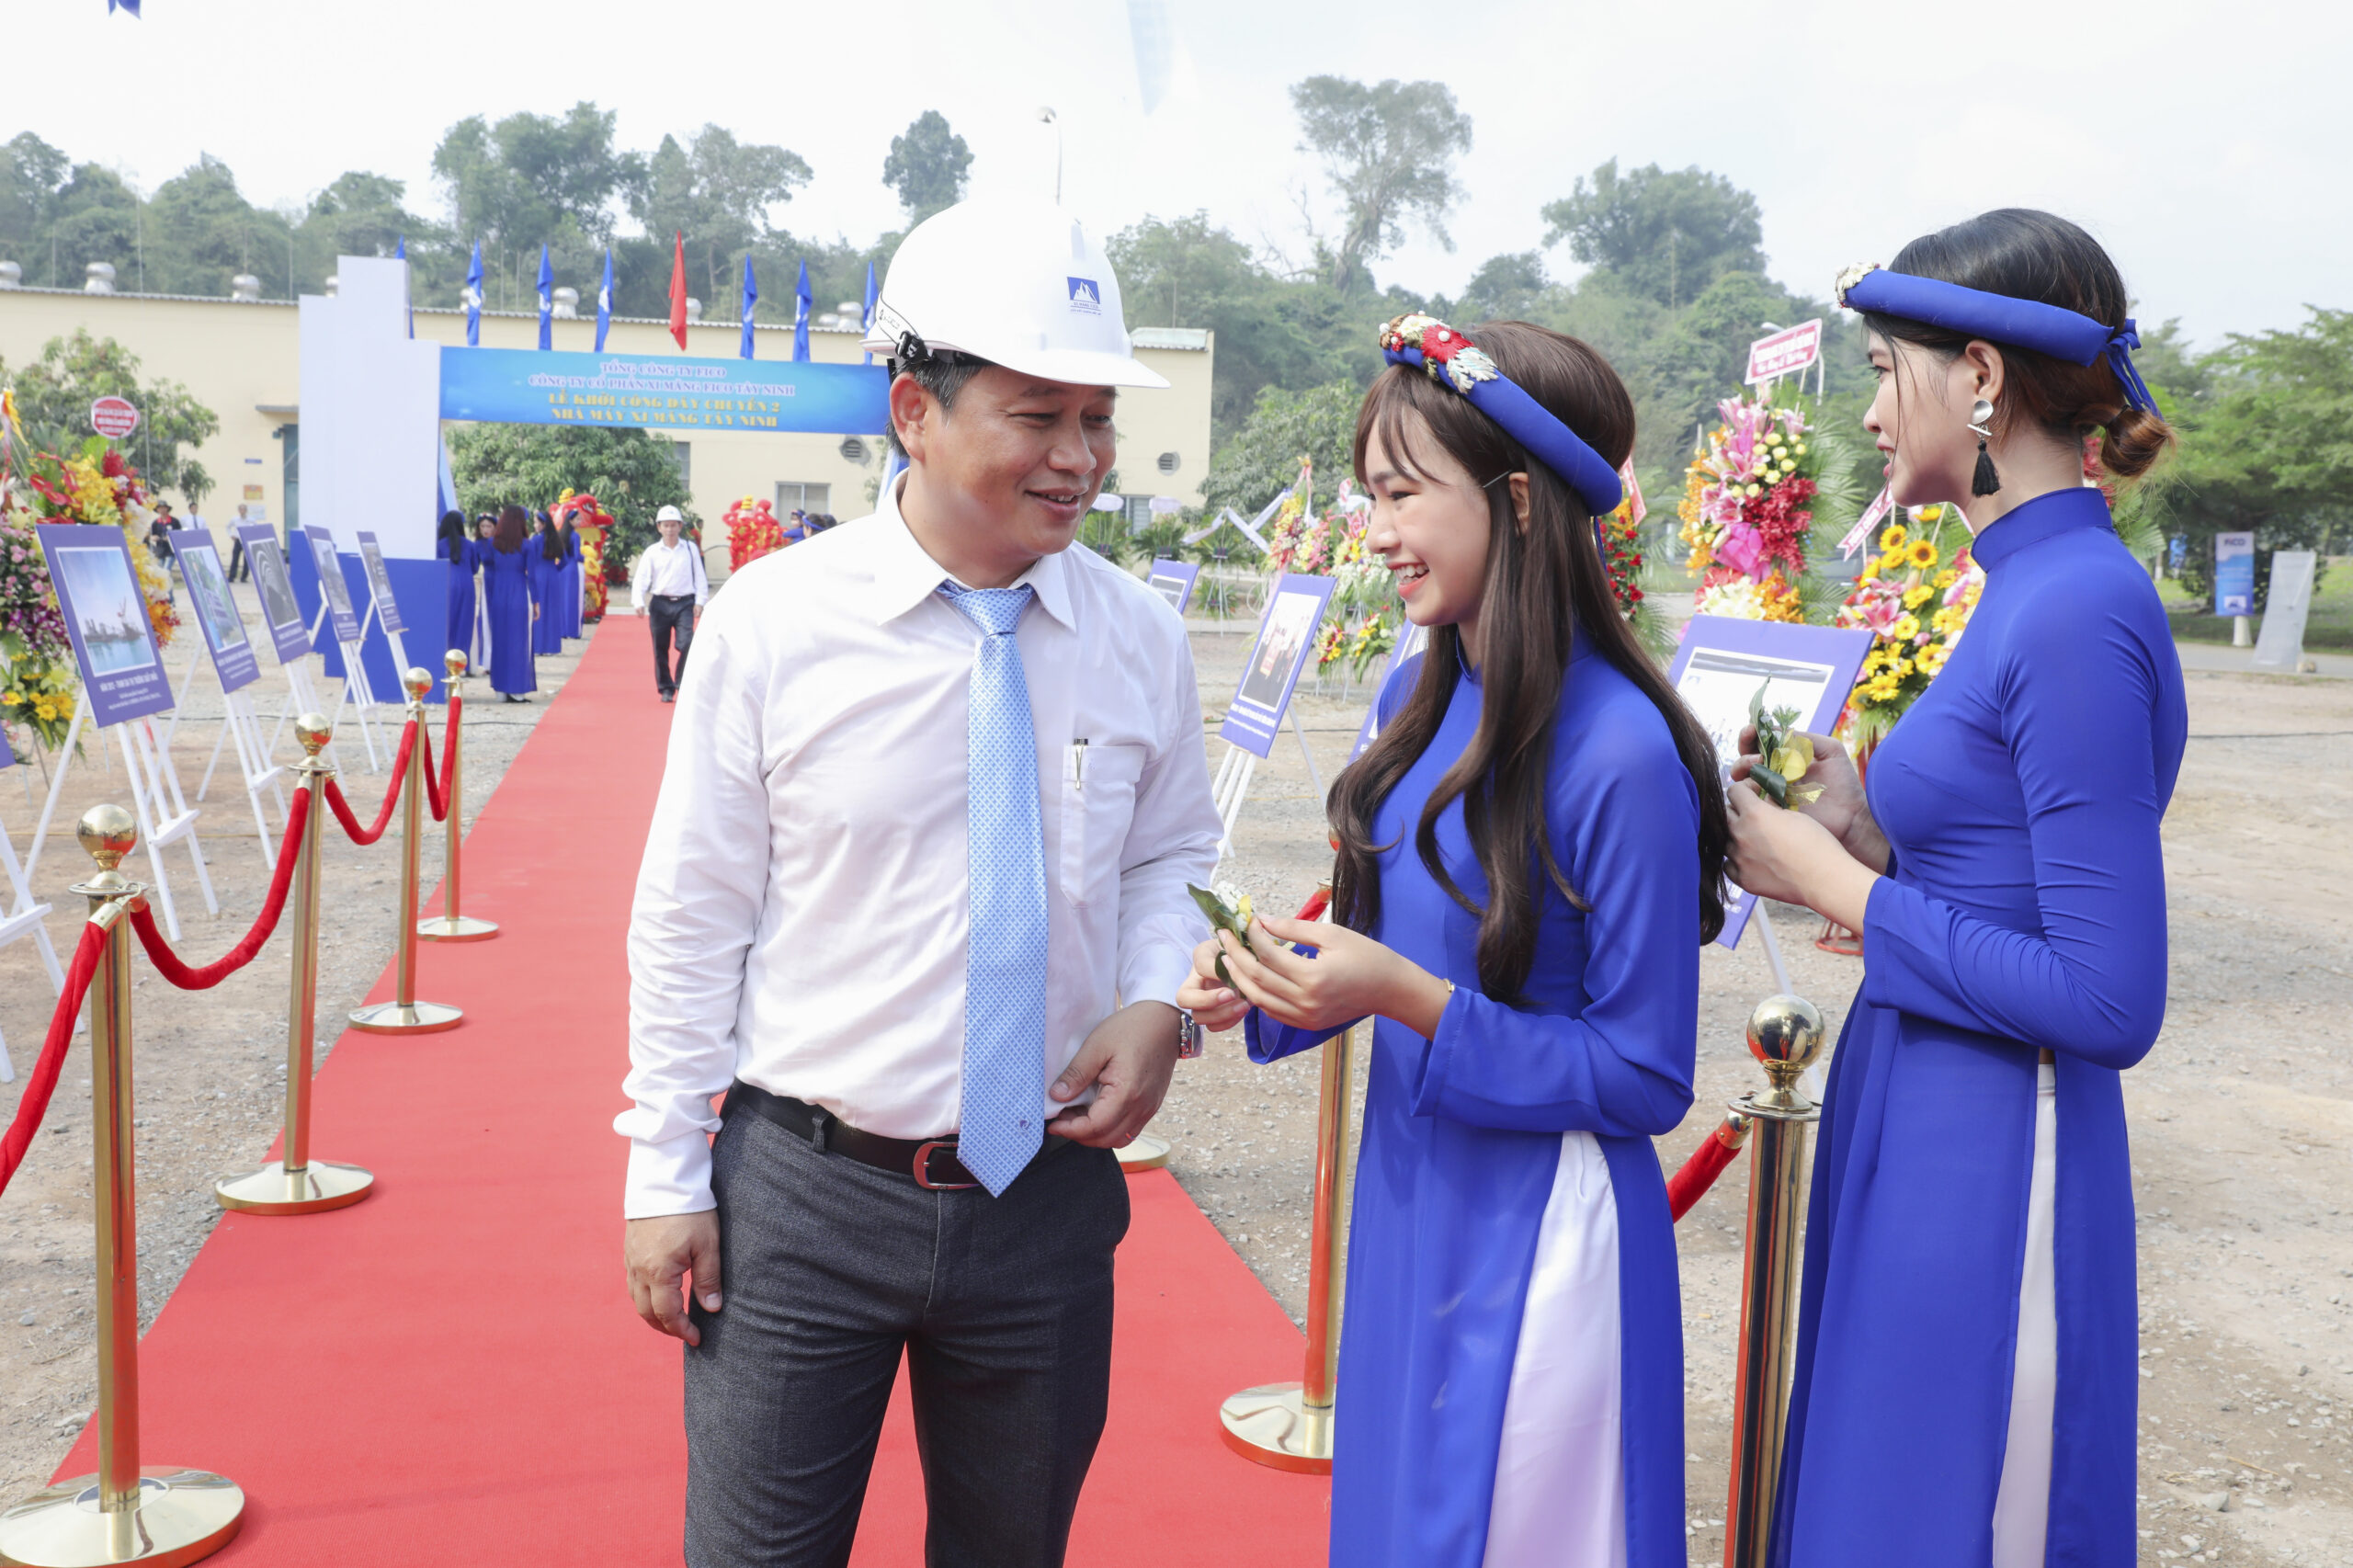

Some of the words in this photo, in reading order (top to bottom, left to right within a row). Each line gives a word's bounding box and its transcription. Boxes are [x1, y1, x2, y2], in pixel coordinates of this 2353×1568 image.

[601, 358, 636, 373] TỔNG
[639, 361, 674, 375] CÔNG
[676, 364, 694, 377] TY
[696, 365, 727, 378] FICO
[529, 372, 567, 386] CÔNG
[569, 376, 585, 388] TY
[646, 379, 661, 392] XI
[702, 381, 733, 394] FICO
[734, 381, 759, 395] TÂY
[761, 384, 796, 396] NINH
[620, 393, 662, 408] CÔNG
[771, 402, 780, 413] 2
[551, 406, 585, 420] NHÀ
[631, 411, 648, 423] XI
[740, 415, 778, 427] NINH
